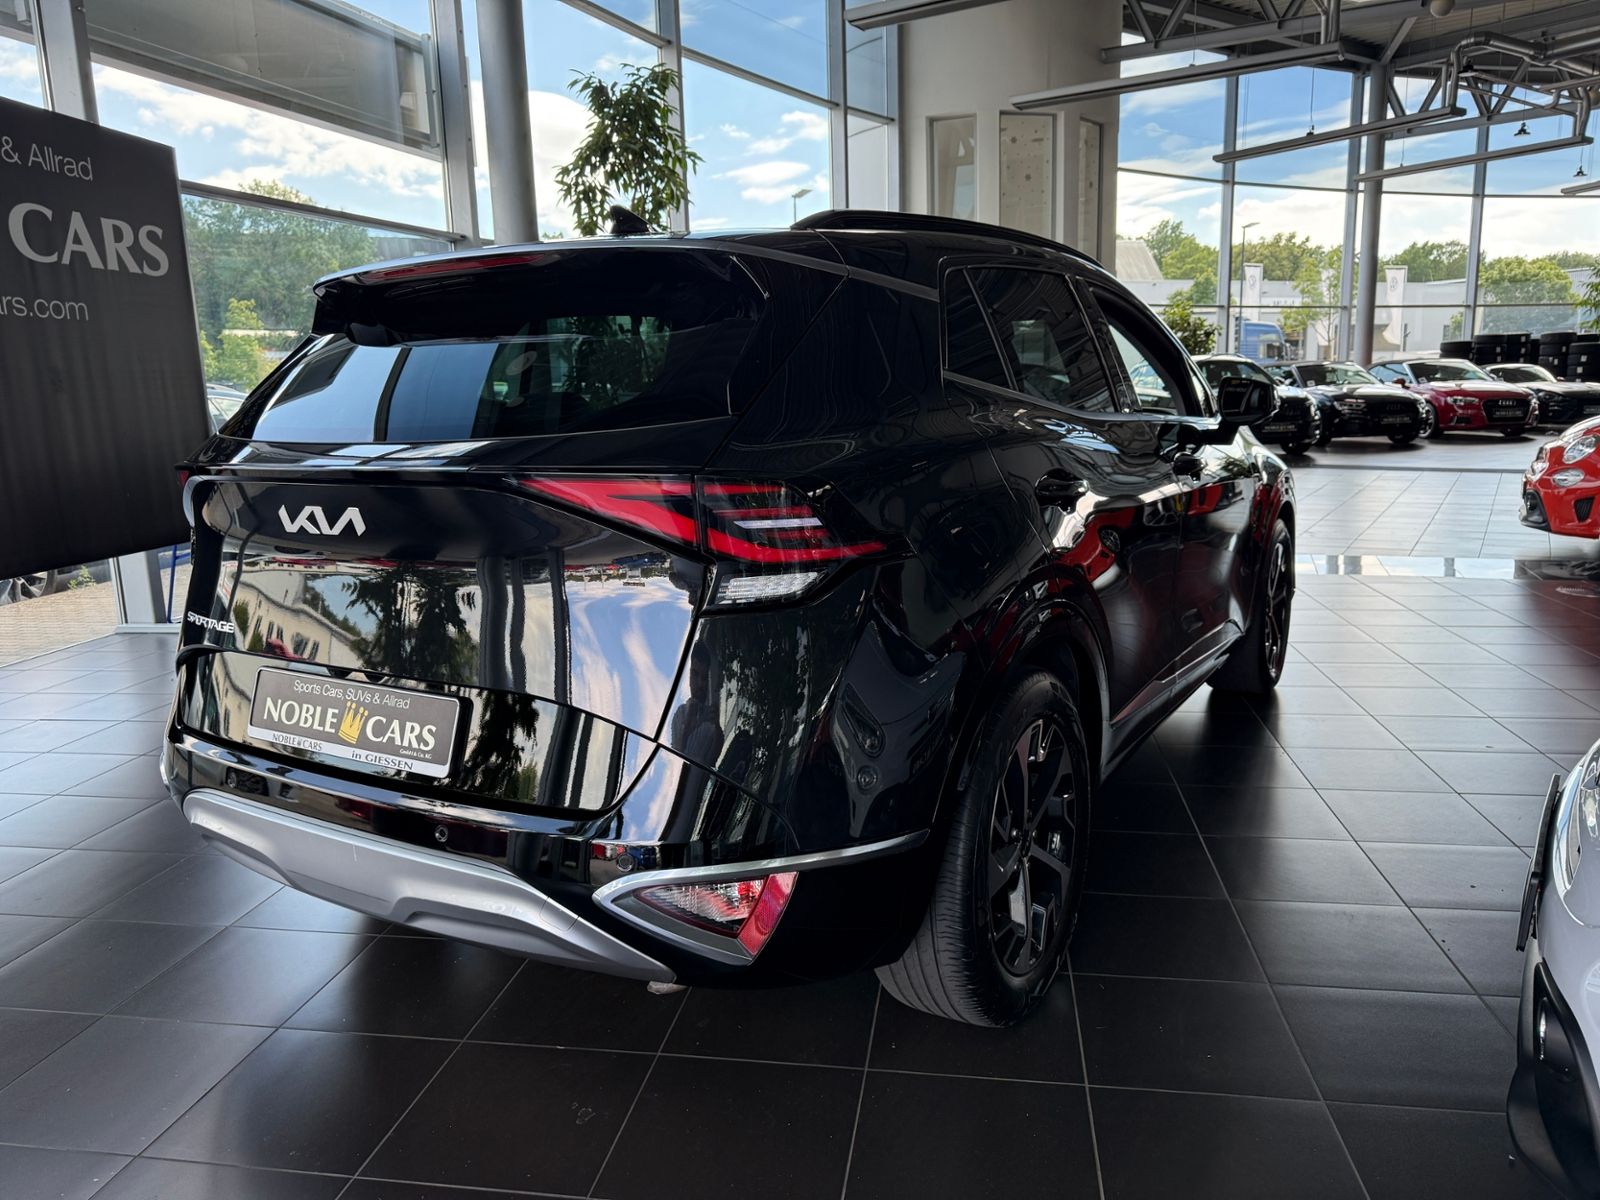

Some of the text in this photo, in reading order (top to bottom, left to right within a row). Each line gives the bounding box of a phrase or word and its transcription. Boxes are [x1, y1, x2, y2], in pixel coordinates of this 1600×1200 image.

[1, 136, 94, 181] & Allrad
[8, 202, 170, 277] CARS
[278, 504, 367, 537] KIA
[187, 610, 235, 634] SPORTAGE
[293, 679, 411, 709] Sports Cars, SUVs & Allrad
[263, 696, 437, 751] NOBLE CARS
[272, 733, 323, 752] NOBLE CARS
[351, 750, 414, 771] in GIESSEN
